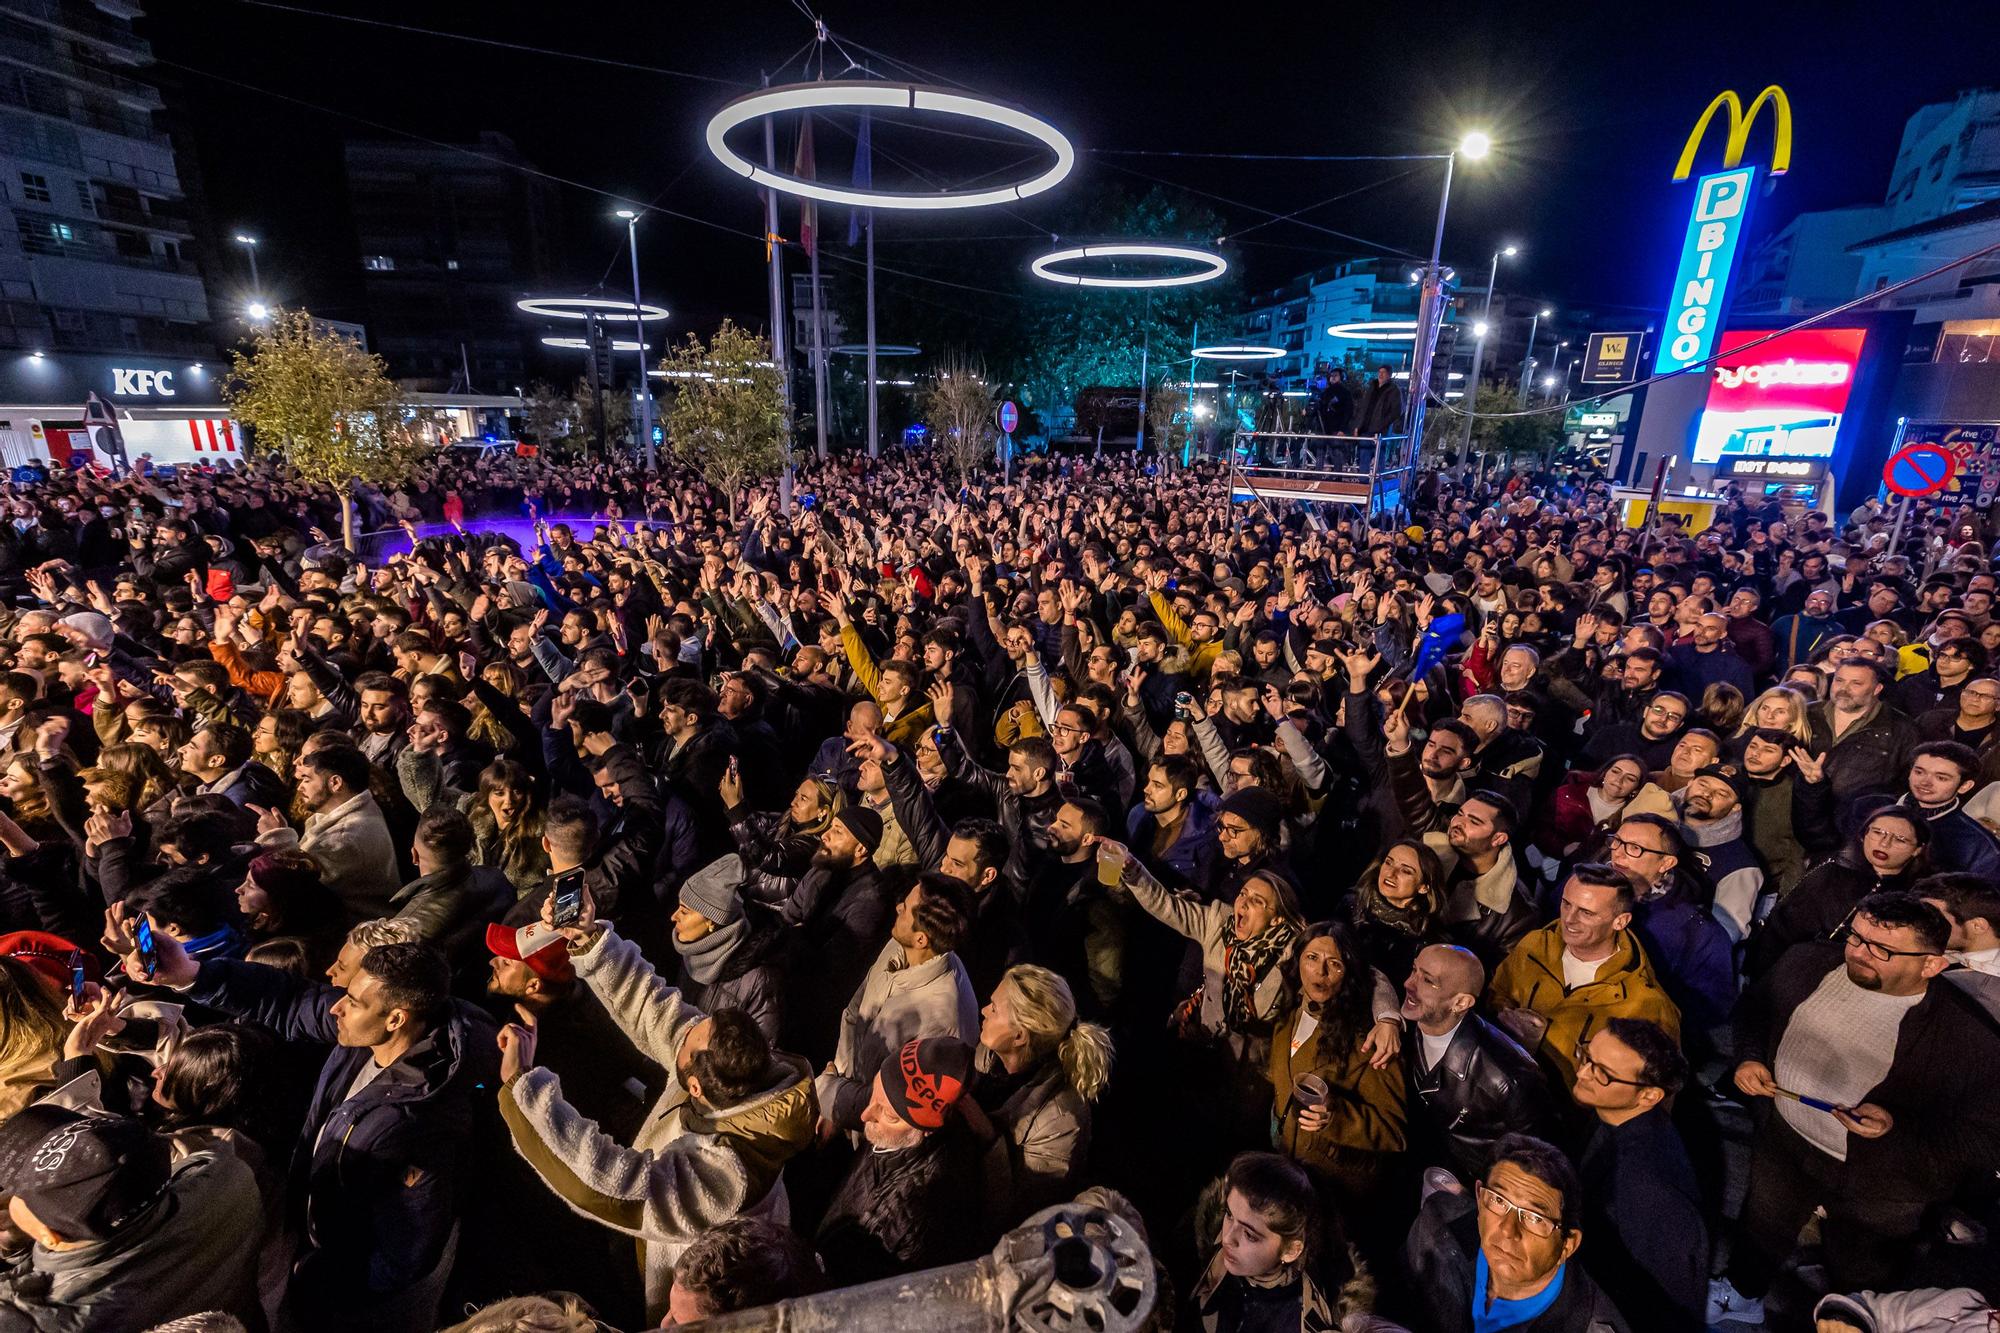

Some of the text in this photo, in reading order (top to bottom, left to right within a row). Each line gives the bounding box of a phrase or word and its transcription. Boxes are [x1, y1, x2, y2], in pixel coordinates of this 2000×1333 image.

[1671, 221, 1726, 361] BINGO
[112, 368, 175, 396] KFC
[1961, 430, 1979, 439] rtve
[1941, 494, 1959, 503] rtve
